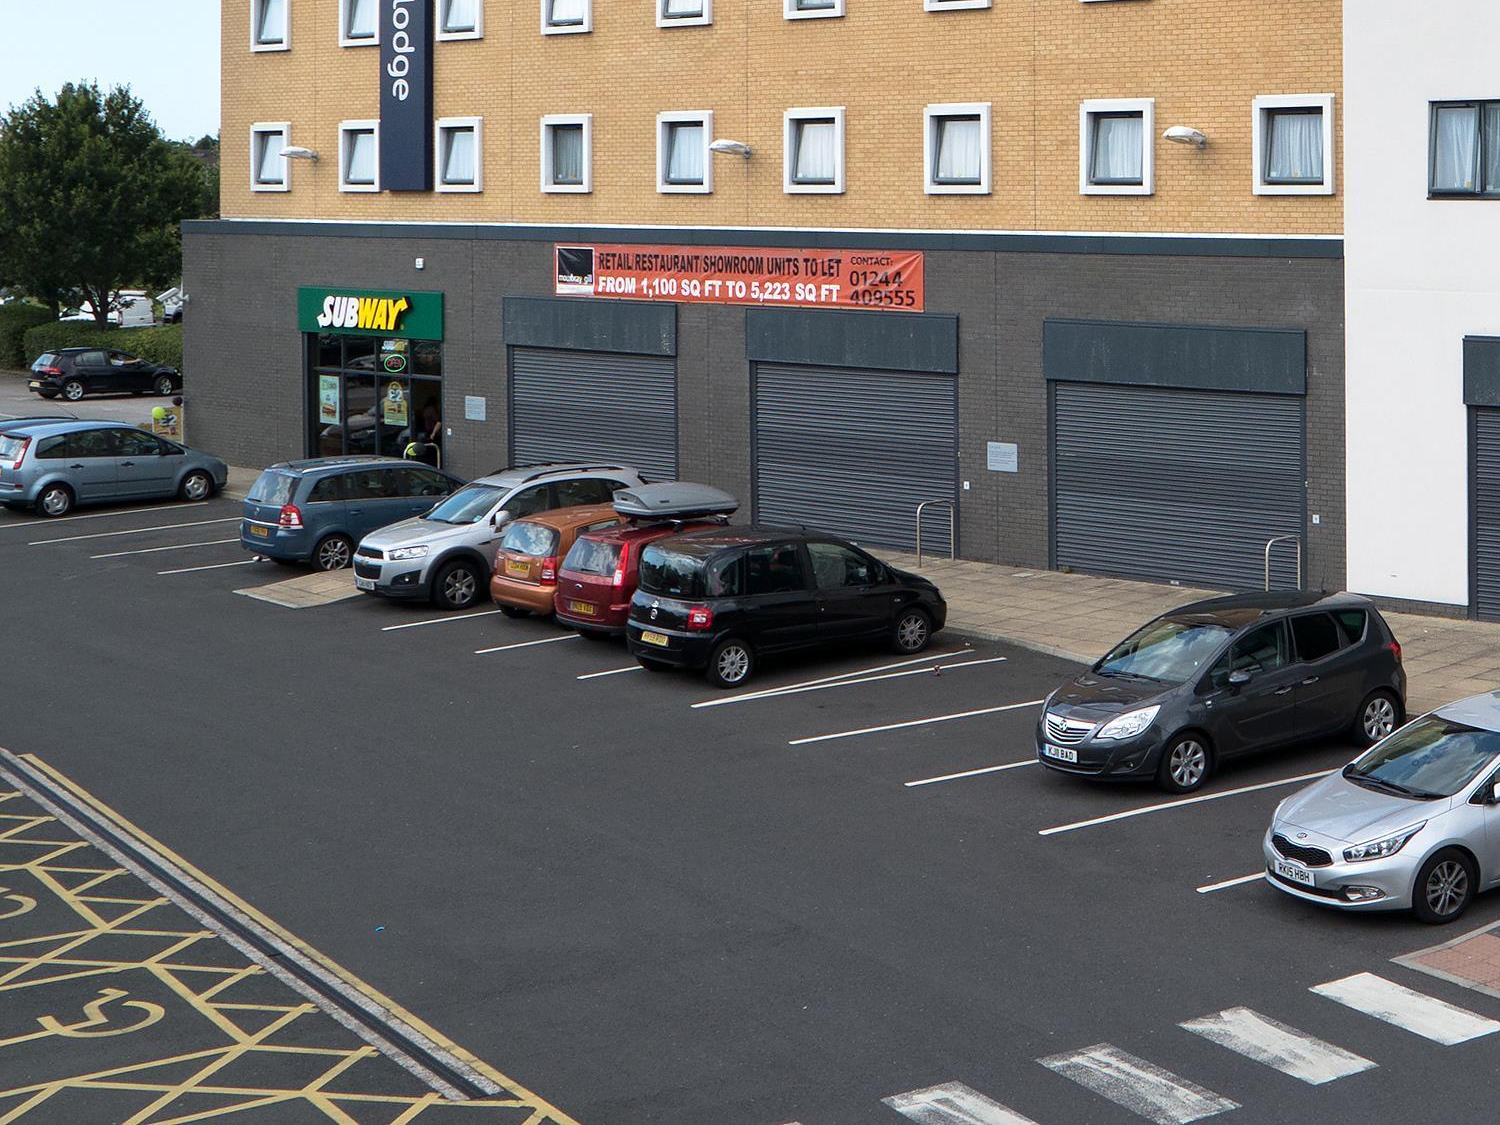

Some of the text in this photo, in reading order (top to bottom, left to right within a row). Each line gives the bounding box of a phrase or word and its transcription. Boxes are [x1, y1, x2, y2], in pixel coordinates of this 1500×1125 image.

[767, 256, 799, 276] UNITS
[803, 258, 818, 277] TO
[821, 258, 842, 277] LET
[850, 256, 893, 267] CONTACT:
[849, 270, 903, 287] 01244
[598, 276, 841, 303] FROM 1,100 SQ FT TO 5,223 SQ FT
[850, 289, 915, 307] 409555
[316, 295, 409, 330] SUBWAY
